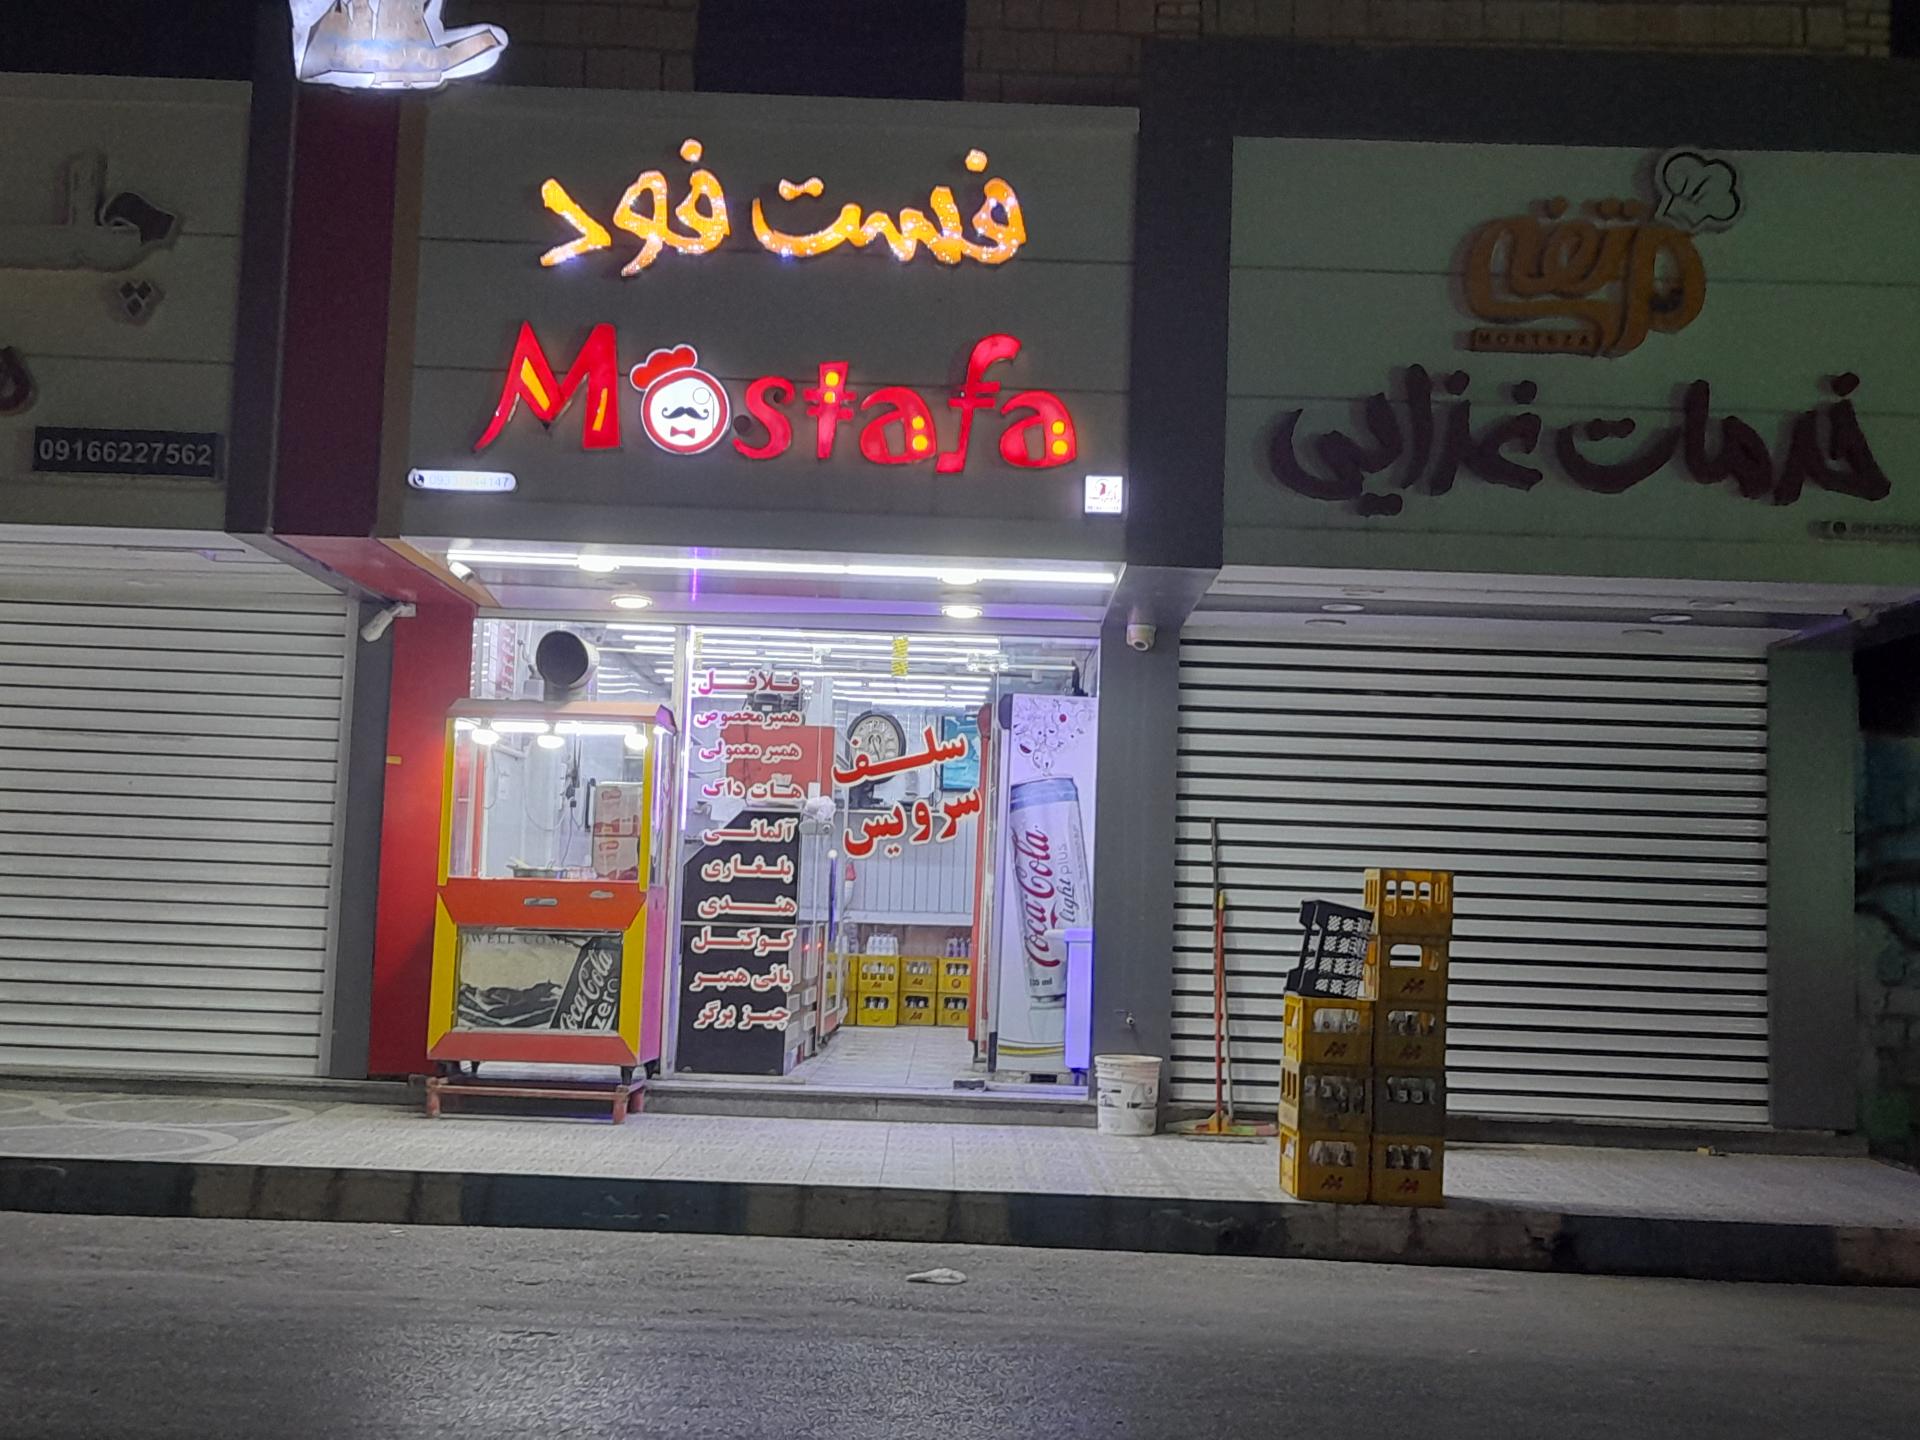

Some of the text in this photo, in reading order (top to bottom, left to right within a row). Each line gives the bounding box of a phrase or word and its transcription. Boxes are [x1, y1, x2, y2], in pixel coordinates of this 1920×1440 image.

[540, 138, 1027, 278] فست فود
[1478, 330, 1594, 347] MORTEZA
[38, 438, 213, 466] 09166227562
[1556, 371, 1892, 505] خدمات
[697, 668, 802, 695] فلافل
[696, 704, 802, 728] همبر مخصوص
[700, 737, 802, 763] همبر معمولی
[832, 725, 969, 787] سلف
[702, 777, 803, 800] هات داگ
[703, 819, 797, 845] آلمانی
[844, 787, 983, 859] سرویس
[701, 853, 794, 884] بلغاری
[1056, 843, 1080, 923] light plus
[698, 894, 797, 919] هندی
[691, 926, 796, 956] کوکتل
[689, 966, 750, 992] همبر
[693, 1000, 736, 1029] برگر
